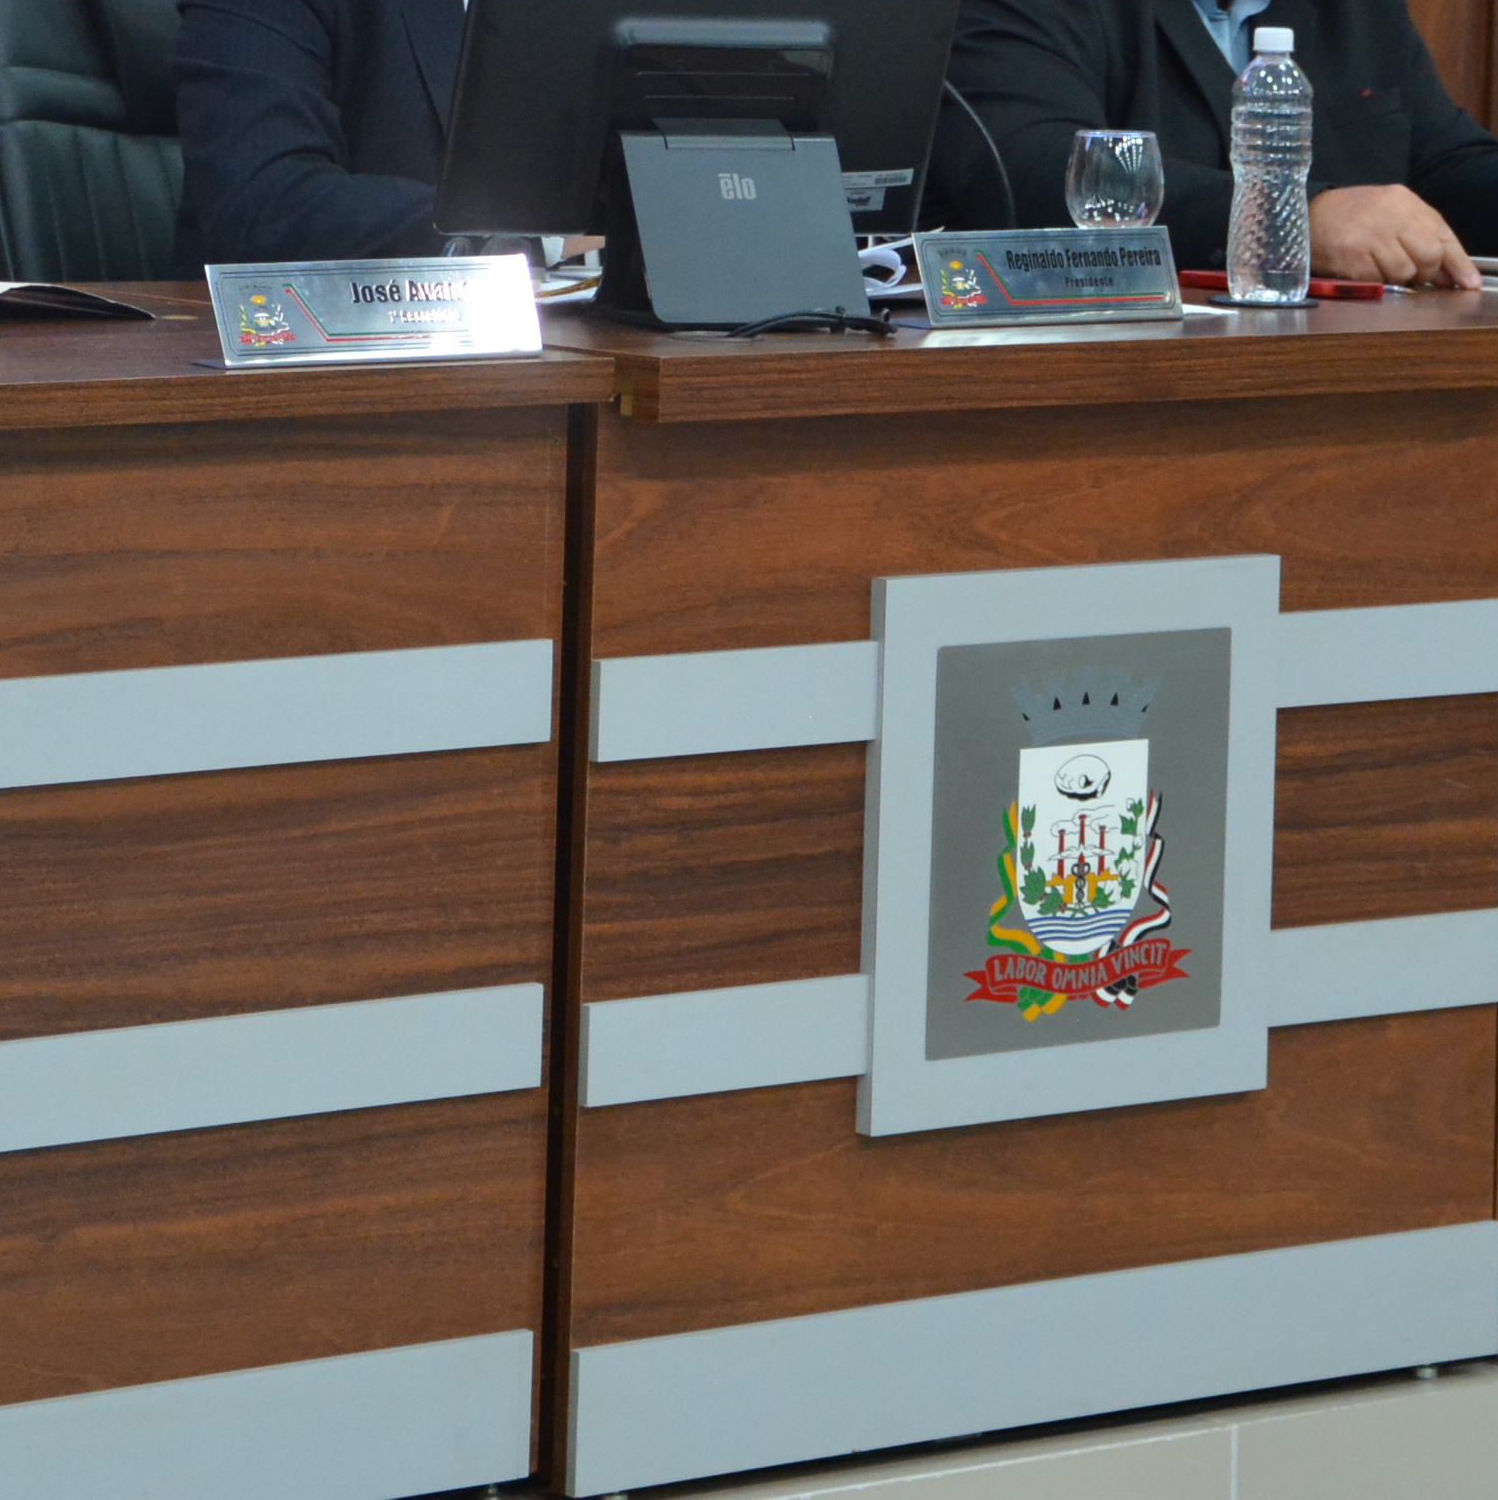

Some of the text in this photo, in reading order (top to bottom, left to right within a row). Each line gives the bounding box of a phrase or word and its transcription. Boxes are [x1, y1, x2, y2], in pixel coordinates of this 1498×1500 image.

[1005, 246, 1162, 272] Reginaldo Fernando Pereira
[350, 279, 402, 304] José
[1064, 276, 1115, 288] Presidente
[993, 941, 1168, 991] LABOR OMNIA VINCIT
